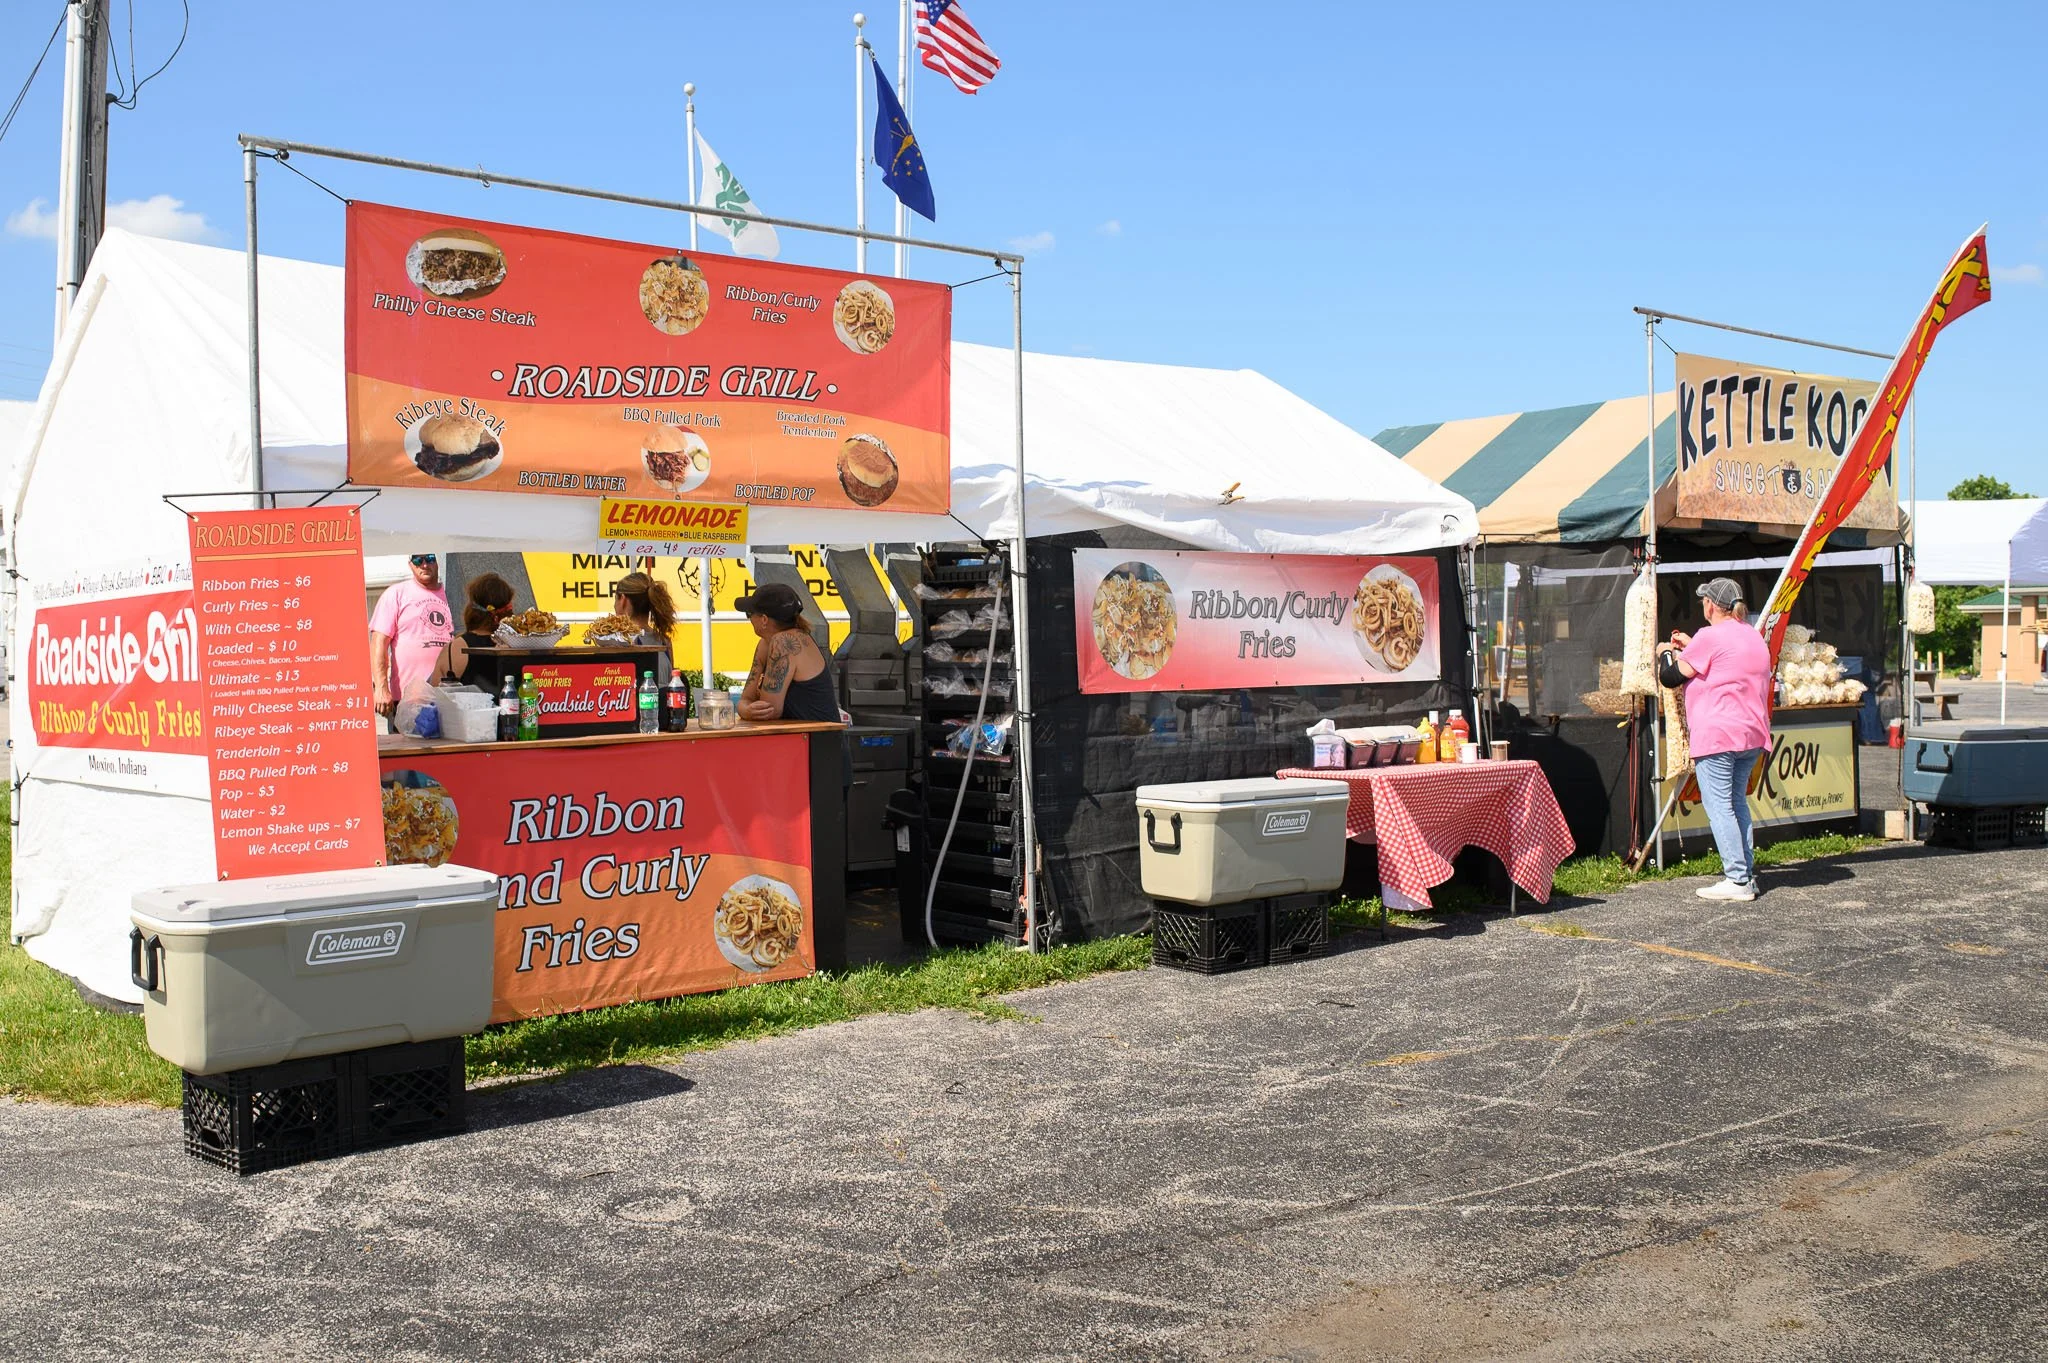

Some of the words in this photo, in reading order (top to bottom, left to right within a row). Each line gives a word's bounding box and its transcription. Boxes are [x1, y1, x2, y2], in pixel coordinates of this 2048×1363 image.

[725, 285, 821, 312] Ribbon/Curly
[372, 293, 420, 316] Philly
[424, 300, 486, 321] Cheese
[490, 308, 537, 327] Steak
[751, 307, 787, 324] Fries
[508, 364, 711, 398] ROADSIDE
[720, 365, 821, 402] GRILL
[395, 398, 453, 430] Ribeye
[459, 397, 507, 436] Steak
[623, 407, 650, 423] BBQ
[654, 409, 691, 426] Pulled
[694, 411, 721, 427] Pork
[776, 411, 820, 424] Breaded
[823, 414, 846, 426] Pork
[1679, 375, 1799, 473] KETTLE
[781, 425, 837, 438] Tenderloin
[518, 471, 580, 489] BOTTLED
[584, 475, 627, 491] WATER
[734, 484, 789, 500] BOTTLED
[791, 487, 815, 502] POP
[607, 503, 742, 528] LEMONADE
[195, 522, 295, 548] ROADSIDE
[301, 519, 357, 543] GRILL
[702, 532, 742, 541] RASPBERRY
[687, 544, 727, 556] refills
[202, 579, 246, 592] Ribbon
[250, 577, 280, 590] Fries
[295, 576, 311, 588] $6
[203, 600, 235, 615] Curly
[238, 599, 268, 612] Fries
[283, 598, 300, 610] $6
[1188, 590, 1348, 626] Ribbon/Curly
[205, 623, 232, 636] With
[235, 622, 281, 634] Cheese
[296, 619, 312, 631] $8
[36, 616, 141, 686] Roadside
[208, 642, 253, 656] Loaded
[1238, 629, 1296, 659] Fries
[294, 654, 312, 664] Sour
[209, 672, 260, 686] Ultimate
[275, 670, 300, 683] $13
[554, 677, 572, 687] FRIES
[593, 676, 613, 686] CURLY
[613, 675, 632, 685] FRIES
[214, 689, 240, 698] Loaded
[241, 688, 256, 696] with
[257, 686, 272, 696] BBQ
[273, 686, 294, 695] Pulled
[295, 685, 310, 693] Pork
[320, 684, 338, 693] Philly
[212, 704, 245, 718] Philly
[248, 702, 293, 715] Cheese
[297, 699, 331, 712] Steak
[346, 697, 368, 709] $11
[597, 688, 631, 717] Grill
[39, 700, 86, 735] Ribbon
[88, 699, 99, 737] &
[102, 700, 150, 748] Curly
[155, 700, 202, 737] Fries
[214, 725, 256, 739] Ribeye
[259, 722, 293, 735] Steak
[308, 721, 337, 732] $MKT
[340, 718, 369, 730] Price
[215, 745, 281, 760] Tenderloin
[295, 743, 320, 755] $10
[118, 757, 147, 776] Indiana
[218, 768, 245, 781] BBQ
[249, 765, 286, 779] Pulled
[290, 764, 317, 776] Pork
[332, 762, 349, 774] $8
[1757, 733, 1820, 801] KORN
[220, 788, 243, 802] Pop
[258, 785, 275, 798] $3
[220, 807, 255, 820] Water
[270, 804, 286, 816] $2
[504, 792, 686, 846] Ribbon
[221, 826, 263, 839] Lemon
[266, 823, 304, 836] Shake
[308, 821, 330, 834] ups
[344, 818, 361, 830] $7
[1269, 816, 1299, 829] Coleman
[248, 844, 266, 855] We
[269, 841, 310, 854] Accept
[314, 838, 349, 850] Cards
[580, 847, 710, 901] Curly
[319, 933, 381, 954] Coleman
[516, 918, 640, 973] Fries
